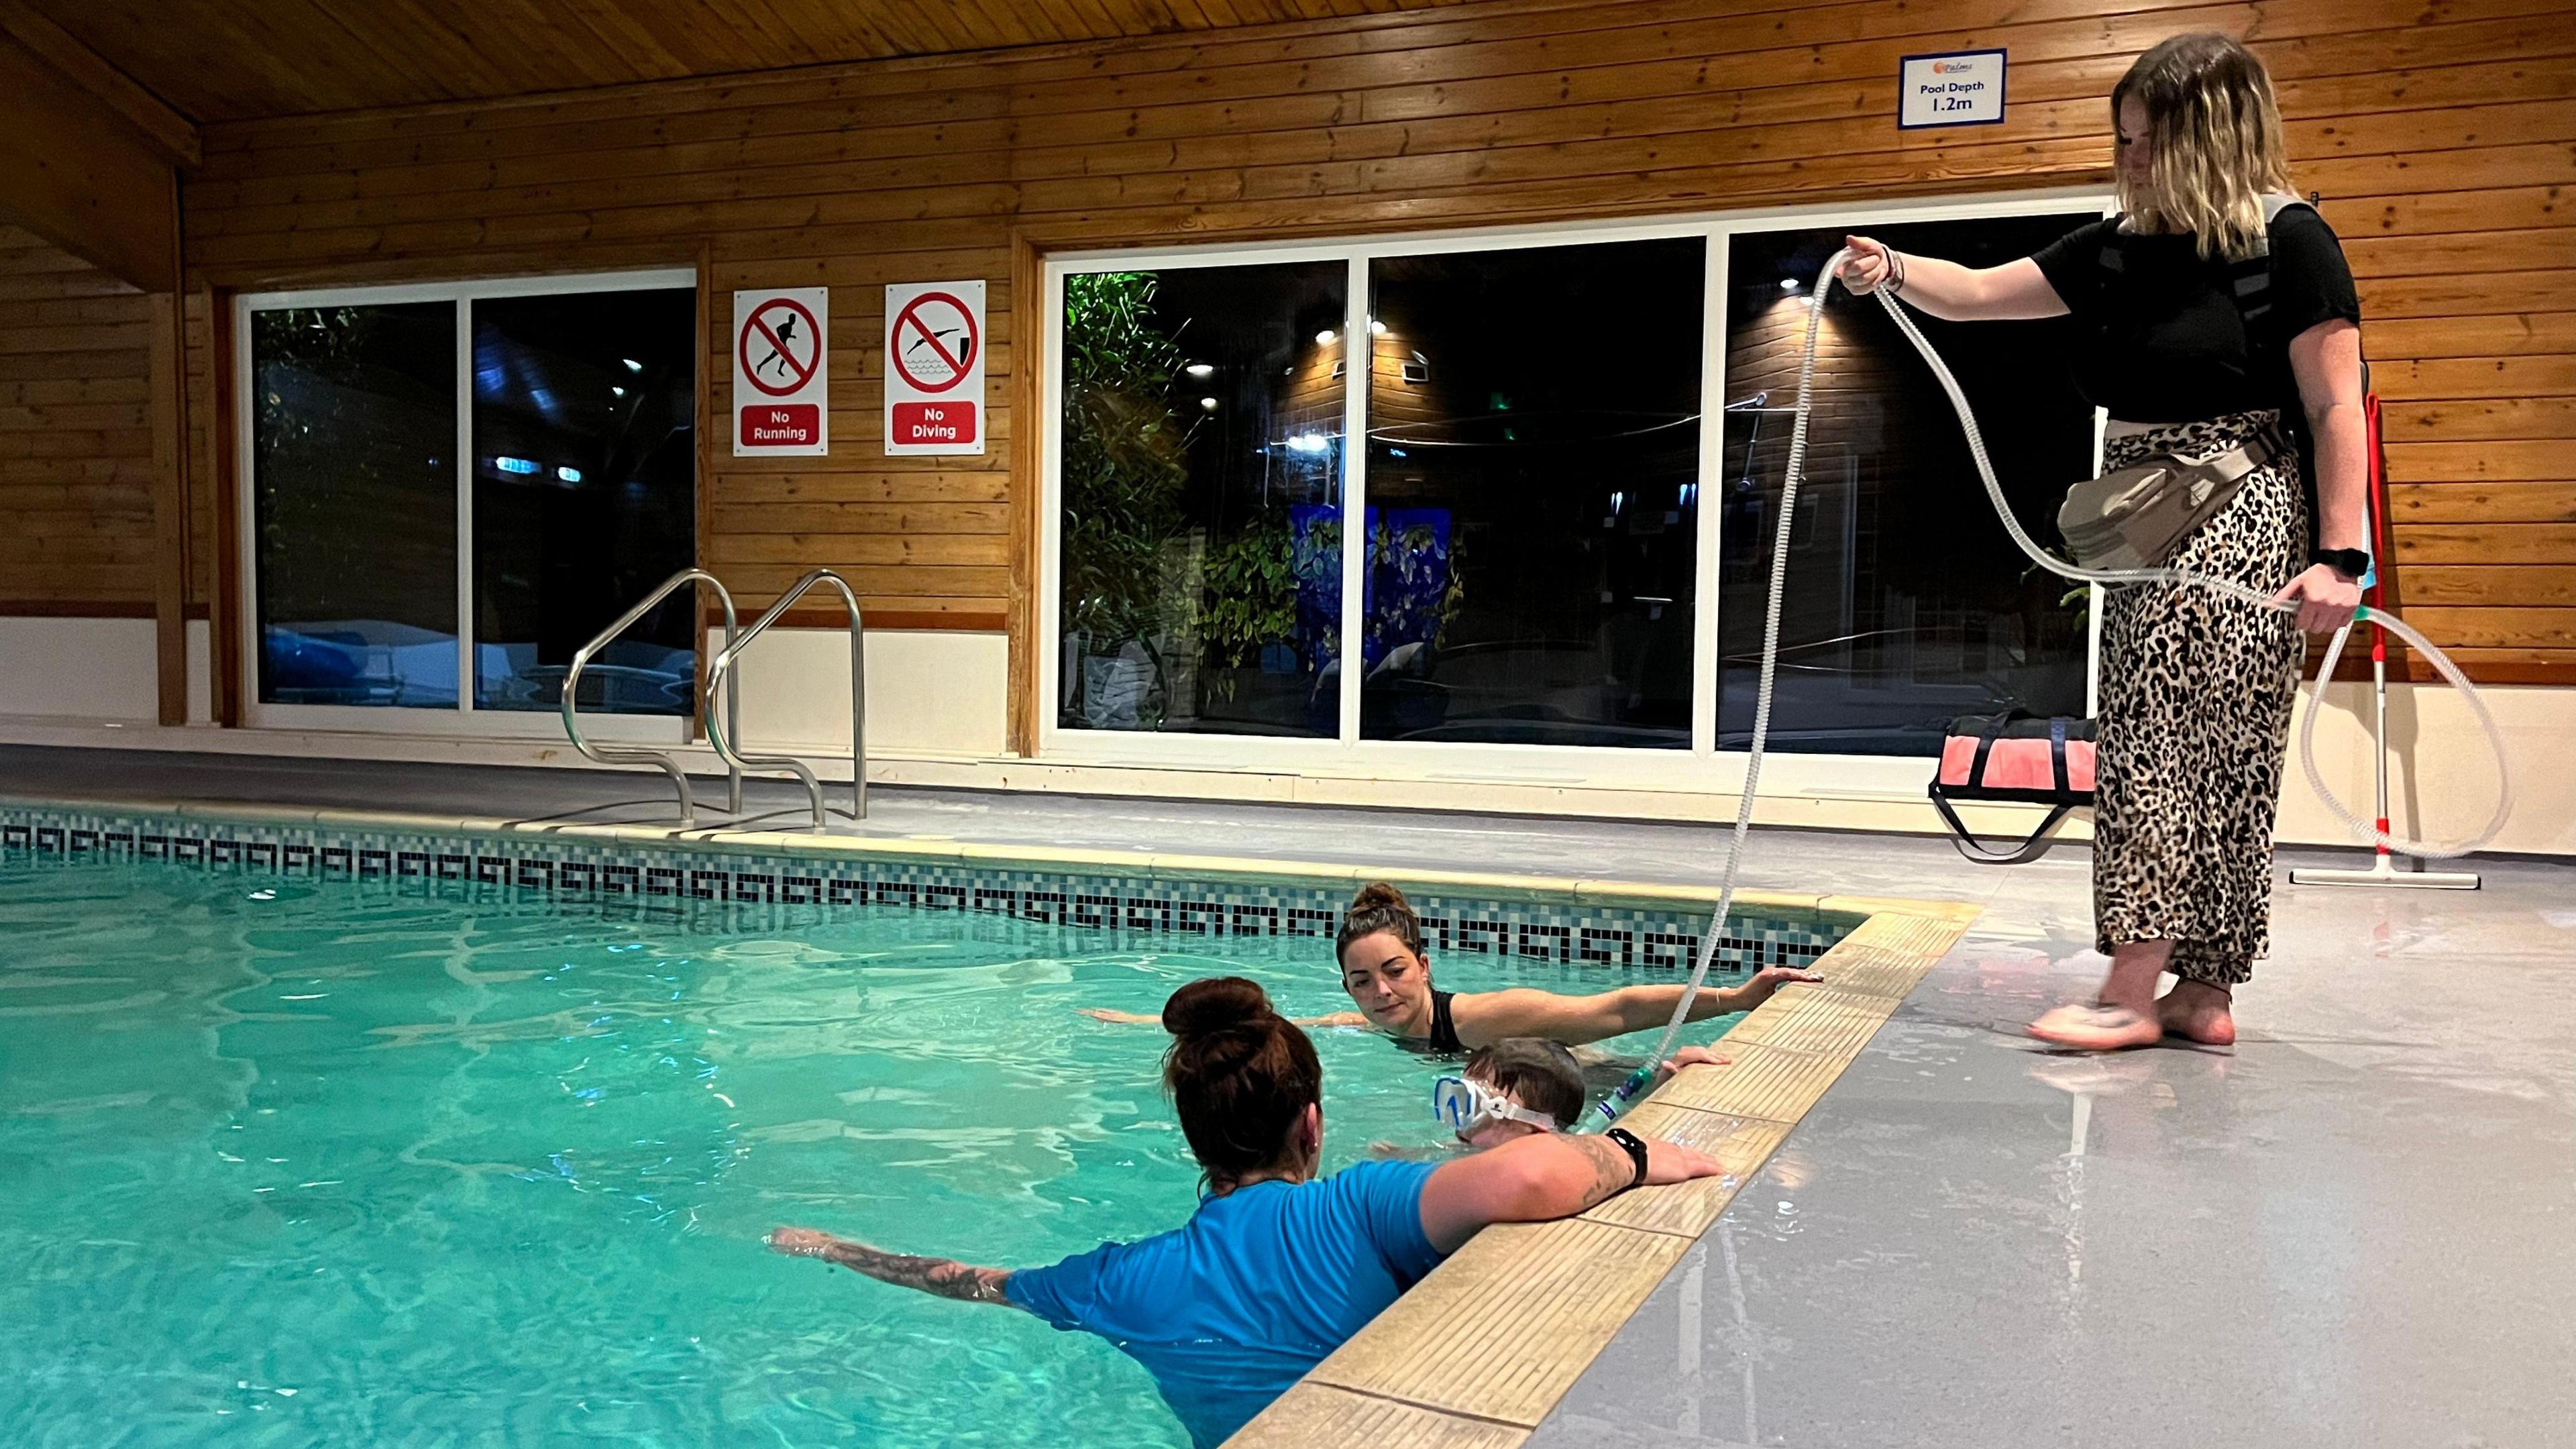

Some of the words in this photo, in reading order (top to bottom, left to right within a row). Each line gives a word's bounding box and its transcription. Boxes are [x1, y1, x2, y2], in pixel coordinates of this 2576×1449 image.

[1921, 83, 1945, 94] Pool
[1949, 81, 1984, 93] Depth
[1933, 97, 1972, 111] 1.2m
[771, 411, 790, 423] No
[924, 408, 945, 421] No
[754, 426, 806, 441] Running
[912, 424, 957, 439] Diving
